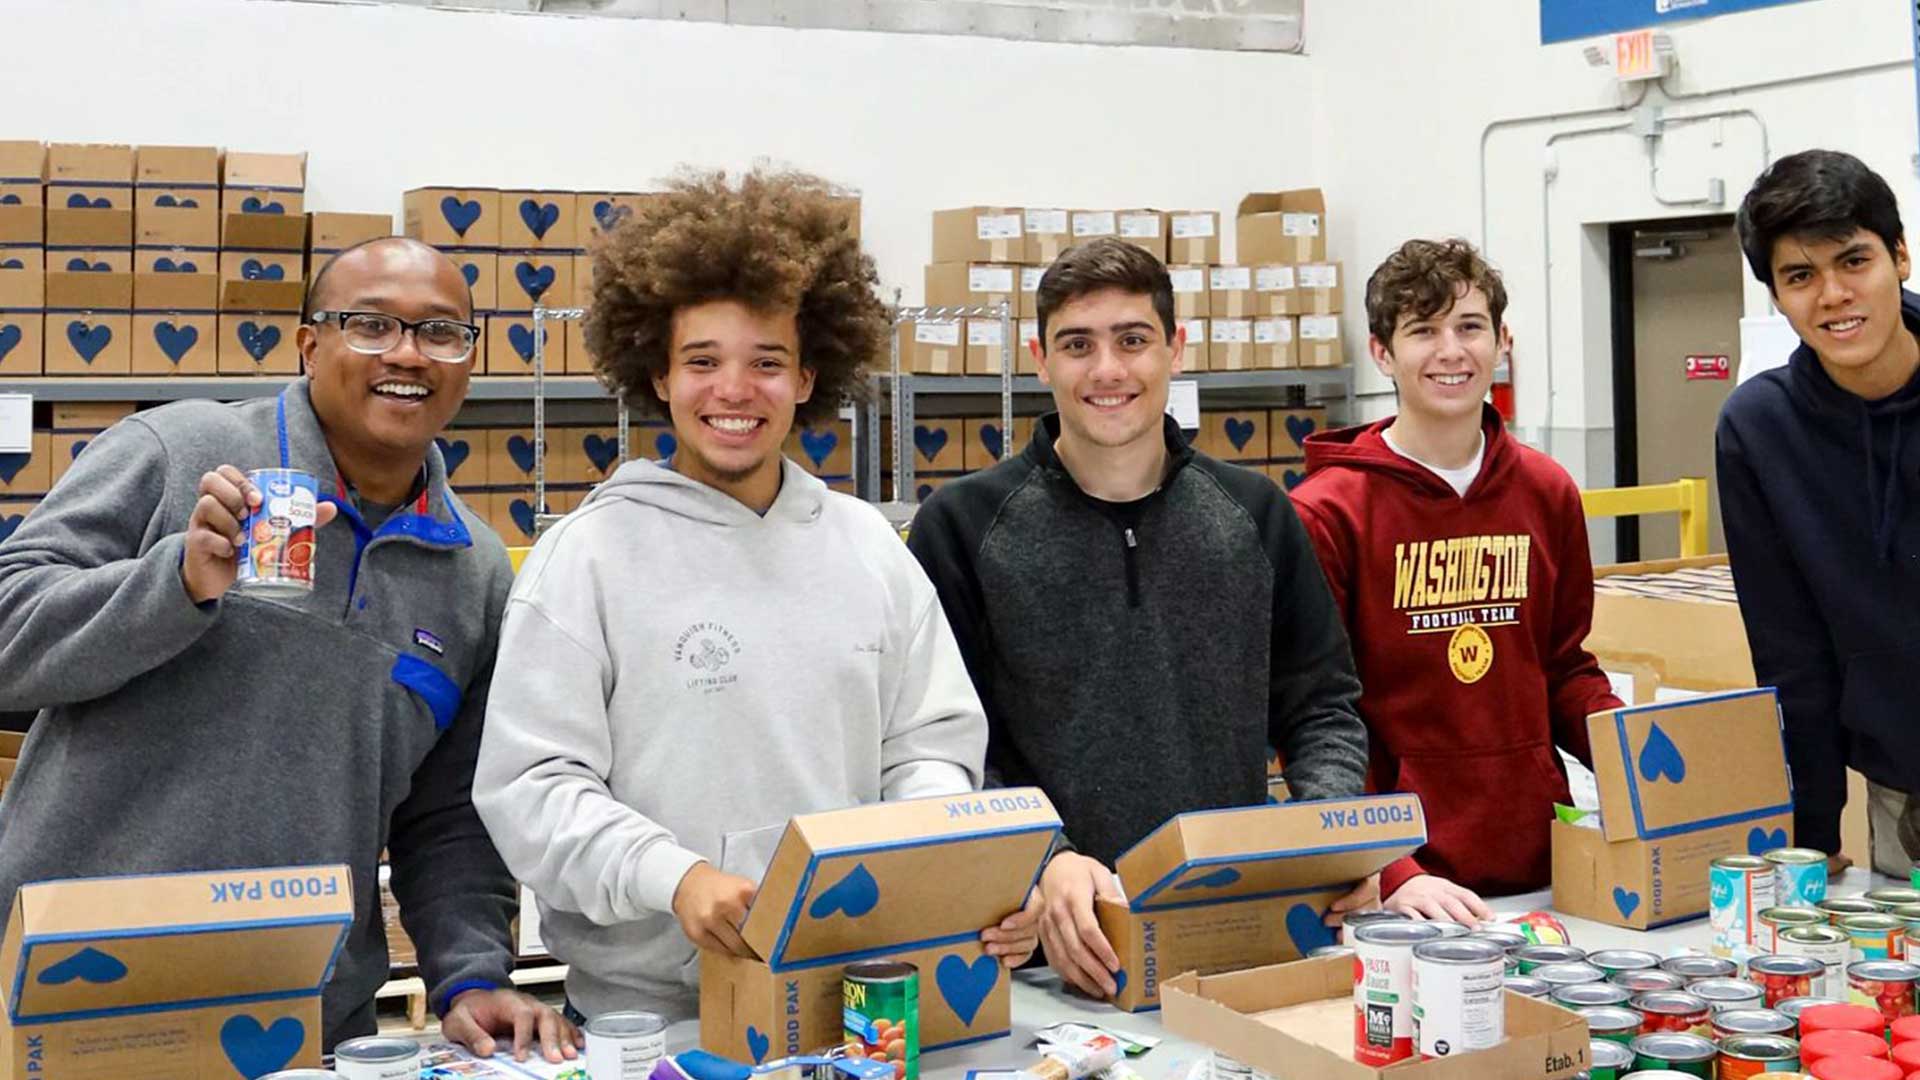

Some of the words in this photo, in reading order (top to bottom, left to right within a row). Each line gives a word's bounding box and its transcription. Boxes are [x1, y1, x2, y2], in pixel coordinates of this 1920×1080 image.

[1617, 32, 1651, 73] EXIT
[1393, 534, 1531, 609] WASHINGTON
[1412, 610, 1475, 629] FOOTBALL
[1481, 607, 1515, 622] TEAM
[1459, 644, 1479, 664] W
[945, 799, 986, 818] PAK
[989, 795, 1042, 813] FOOD
[1363, 804, 1413, 825] FOOD
[1320, 808, 1359, 829] PAK
[1652, 847, 1662, 876] PAK
[211, 880, 263, 903] PAK
[269, 876, 337, 899] FOOD
[1653, 878, 1662, 916] FOOD
[1143, 921, 1156, 953] PAK
[1144, 956, 1156, 998] FOOD
[1366, 958, 1390, 974] PASTA
[786, 979, 799, 1015] PAK
[787, 1019, 800, 1054] OOD
[27, 1034, 43, 1073] PAK
[1545, 1052, 1575, 1073] Etab.
[1577, 1048, 1584, 1064] 1
